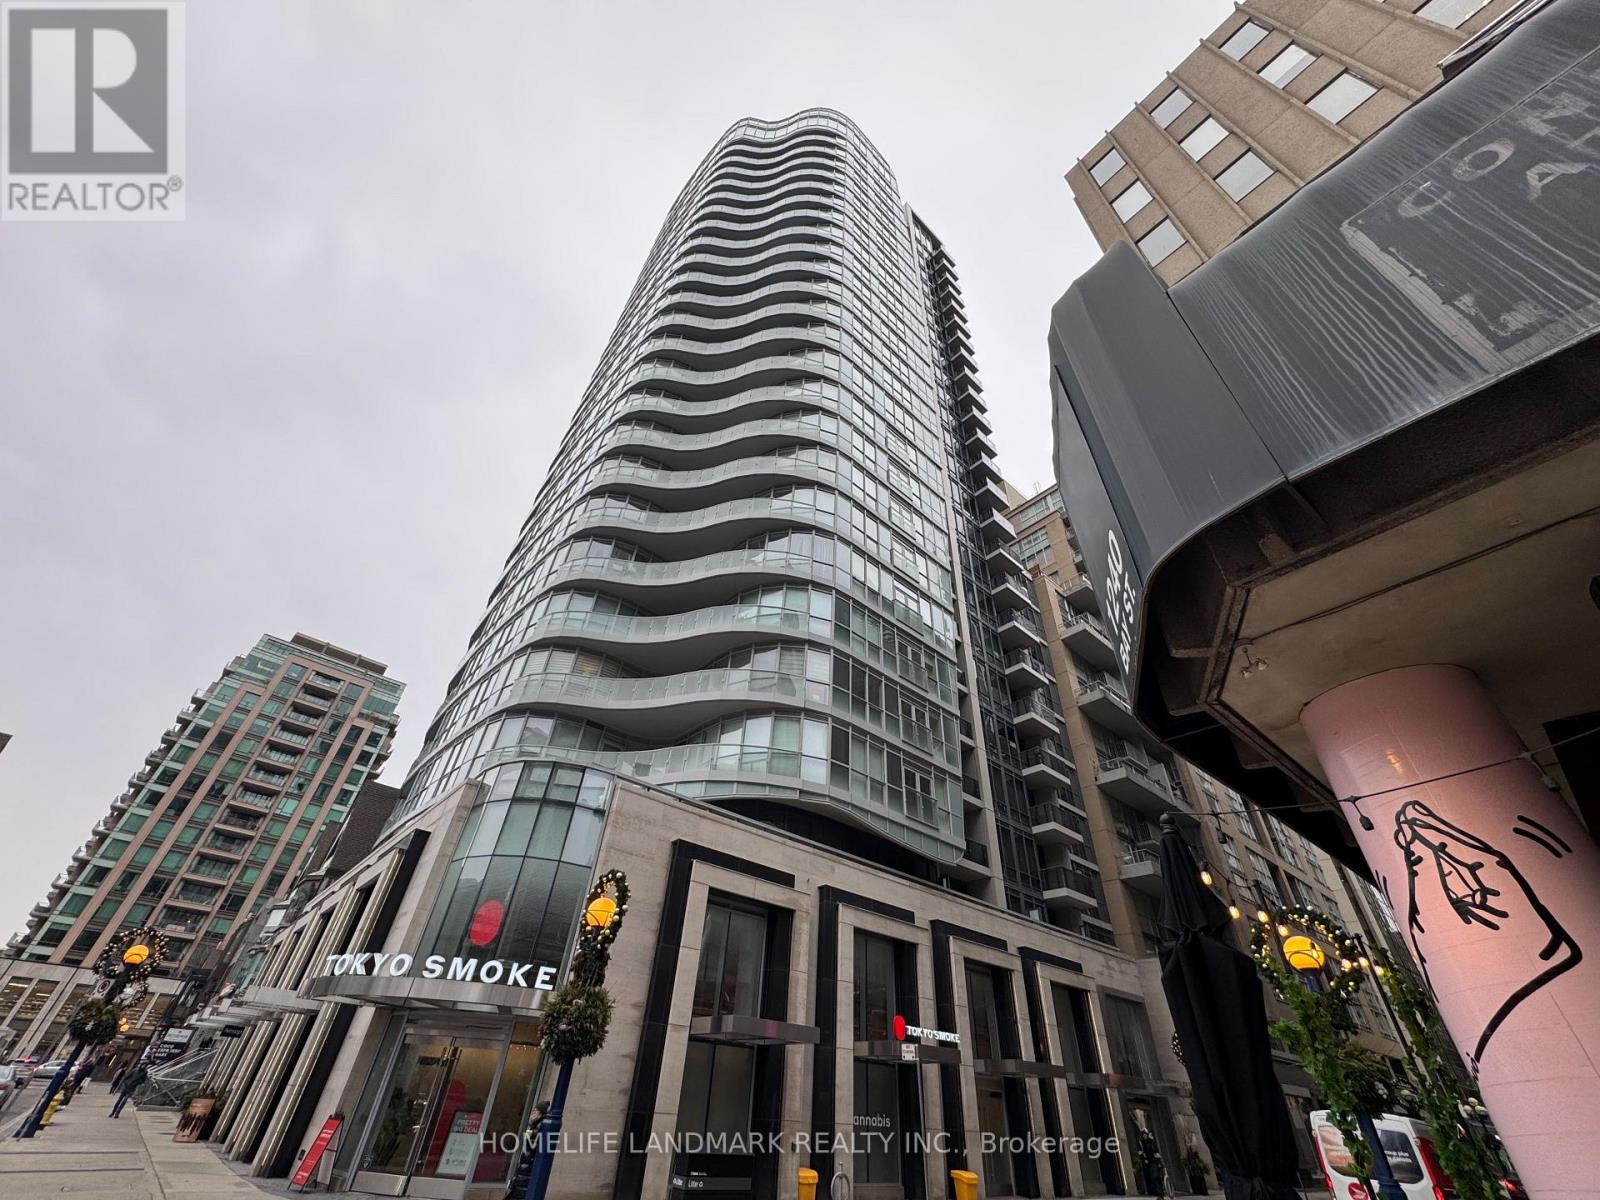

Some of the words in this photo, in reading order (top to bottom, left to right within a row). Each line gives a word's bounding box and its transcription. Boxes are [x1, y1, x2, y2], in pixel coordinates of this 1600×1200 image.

[1106, 529, 1123, 636] 1240
[1123, 571, 1136, 624] ST.
[1119, 611, 1132, 675] BAY
[326, 952, 413, 977] TOKYO
[422, 955, 557, 990] SMOKE
[905, 1025, 933, 1039] TOKYO
[933, 1030, 961, 1043] SMOKE
[853, 1113, 891, 1127] annabis
